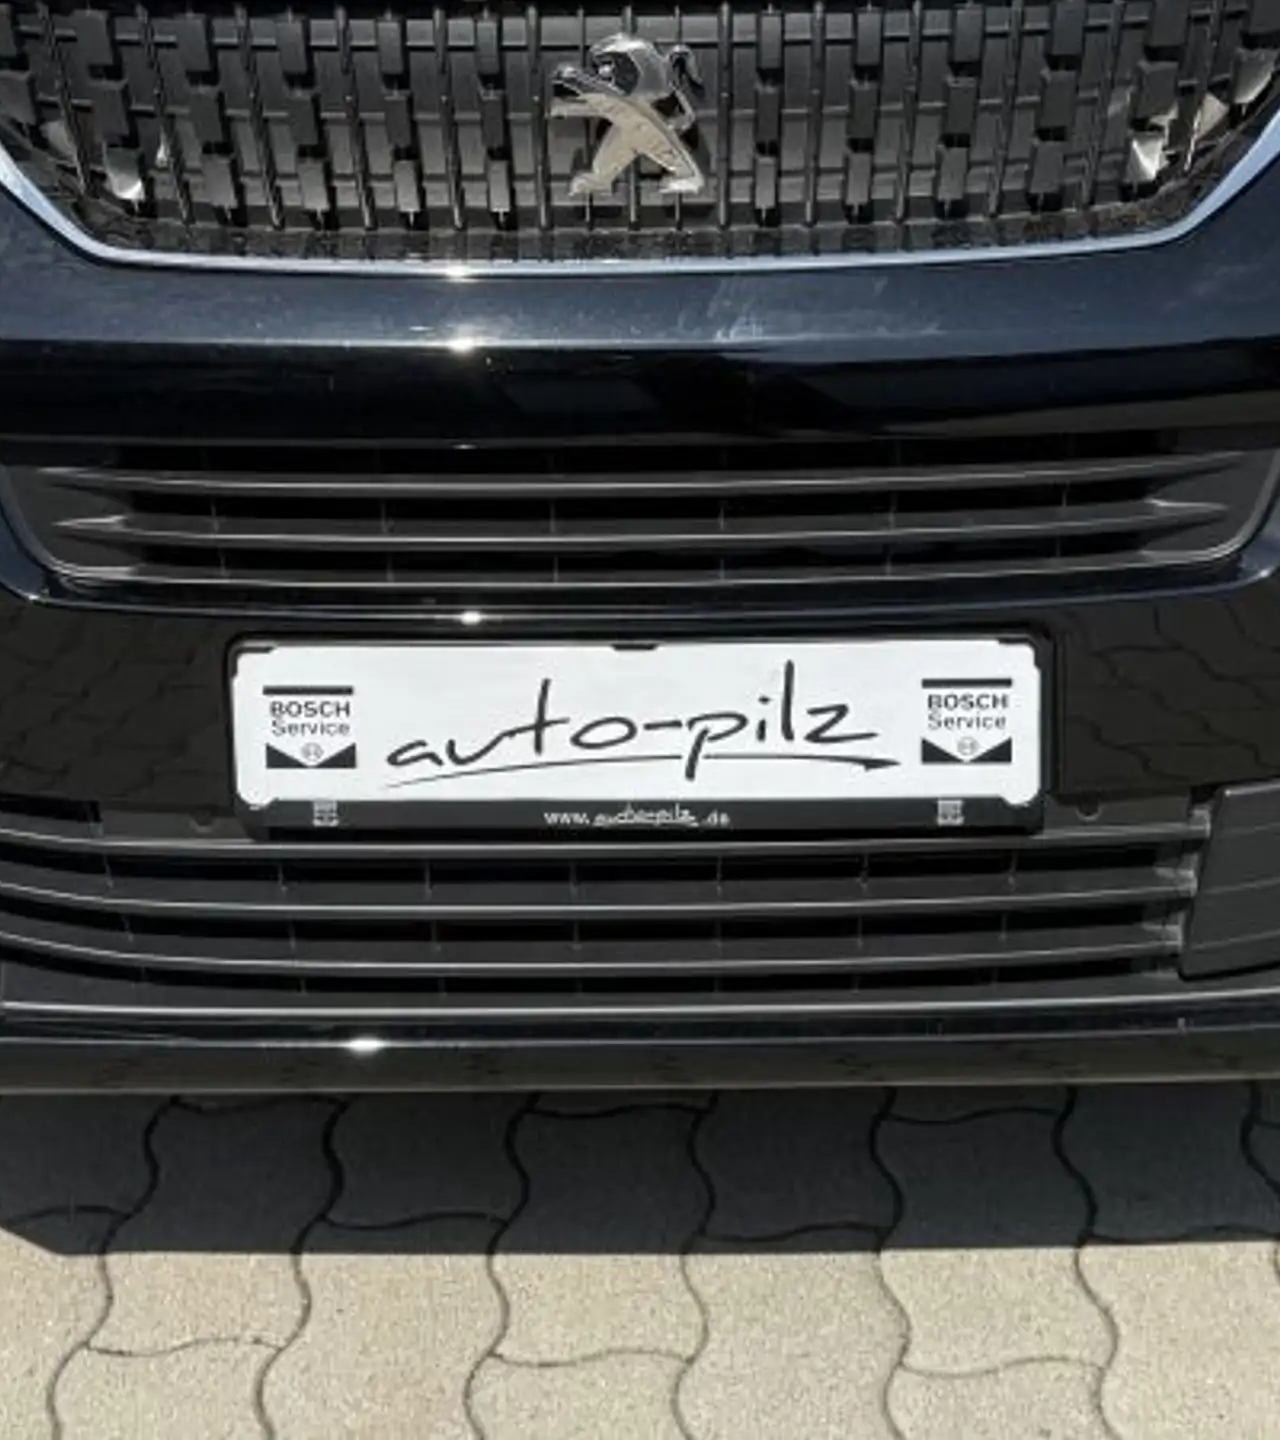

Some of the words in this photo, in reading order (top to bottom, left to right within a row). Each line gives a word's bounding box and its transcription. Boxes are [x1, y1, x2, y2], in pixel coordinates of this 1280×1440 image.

[270, 700, 351, 718] BOSCH
[927, 693, 1010, 711] BOSCH
[271, 718, 351, 737] Service
[386, 659, 879, 781] auto-pilz
[927, 709, 1007, 731] Service
